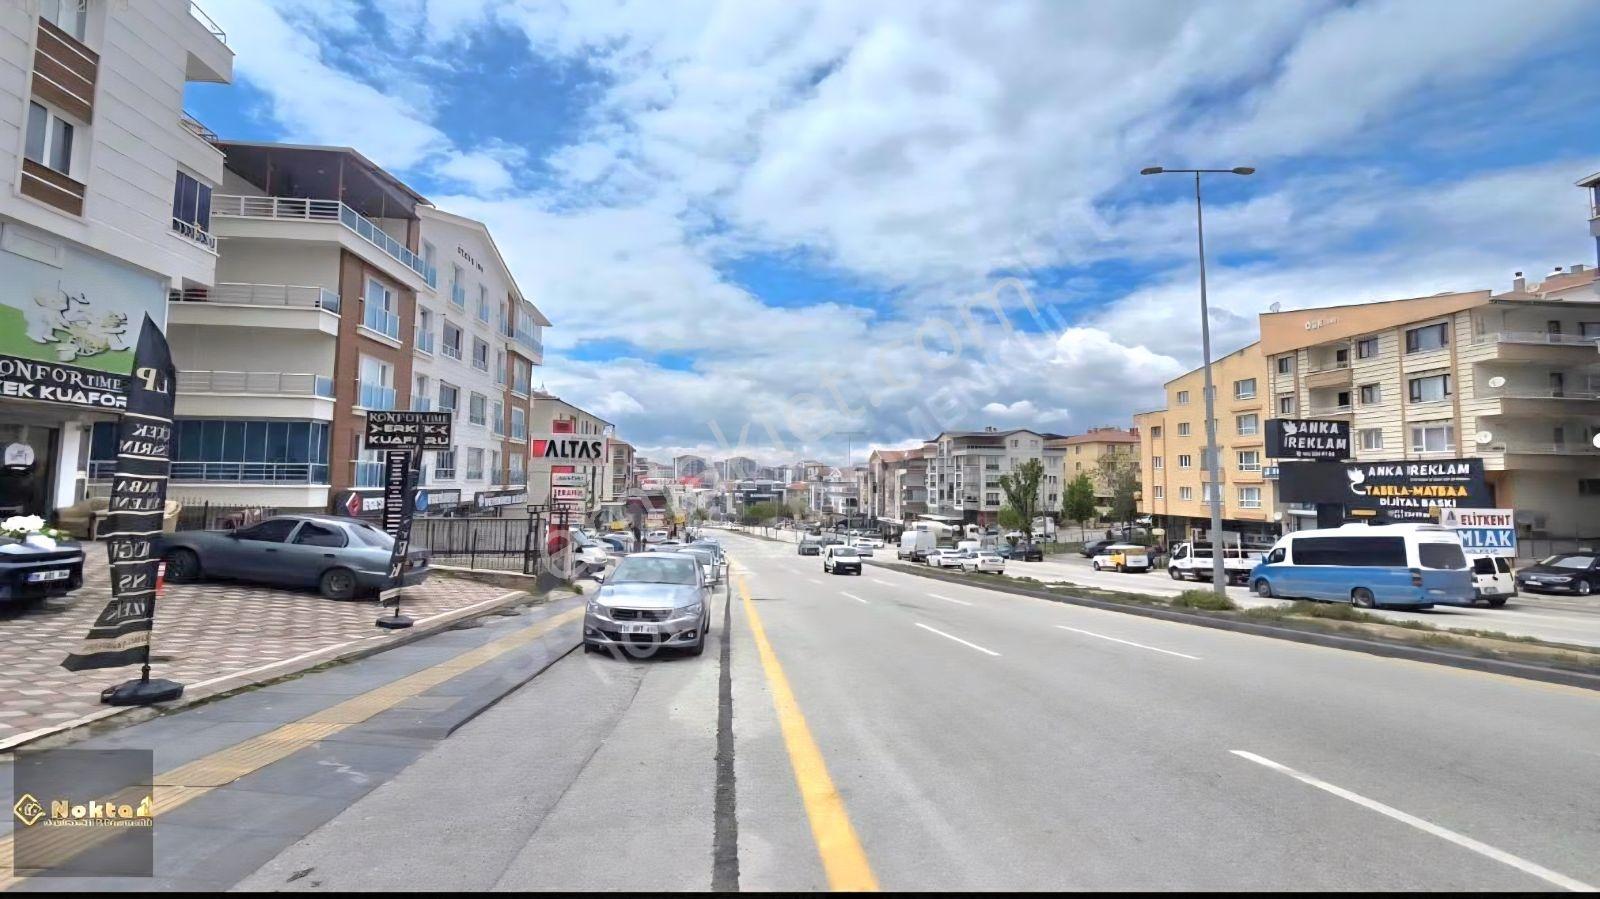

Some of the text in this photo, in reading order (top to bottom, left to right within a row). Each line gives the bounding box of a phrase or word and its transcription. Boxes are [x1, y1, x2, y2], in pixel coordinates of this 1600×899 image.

[86, 374, 121, 390] TIME
[1299, 421, 1339, 434] ANKA
[1285, 436, 1347, 450] REKLAM
[1368, 463, 1470, 476] ANKA REKLAM
